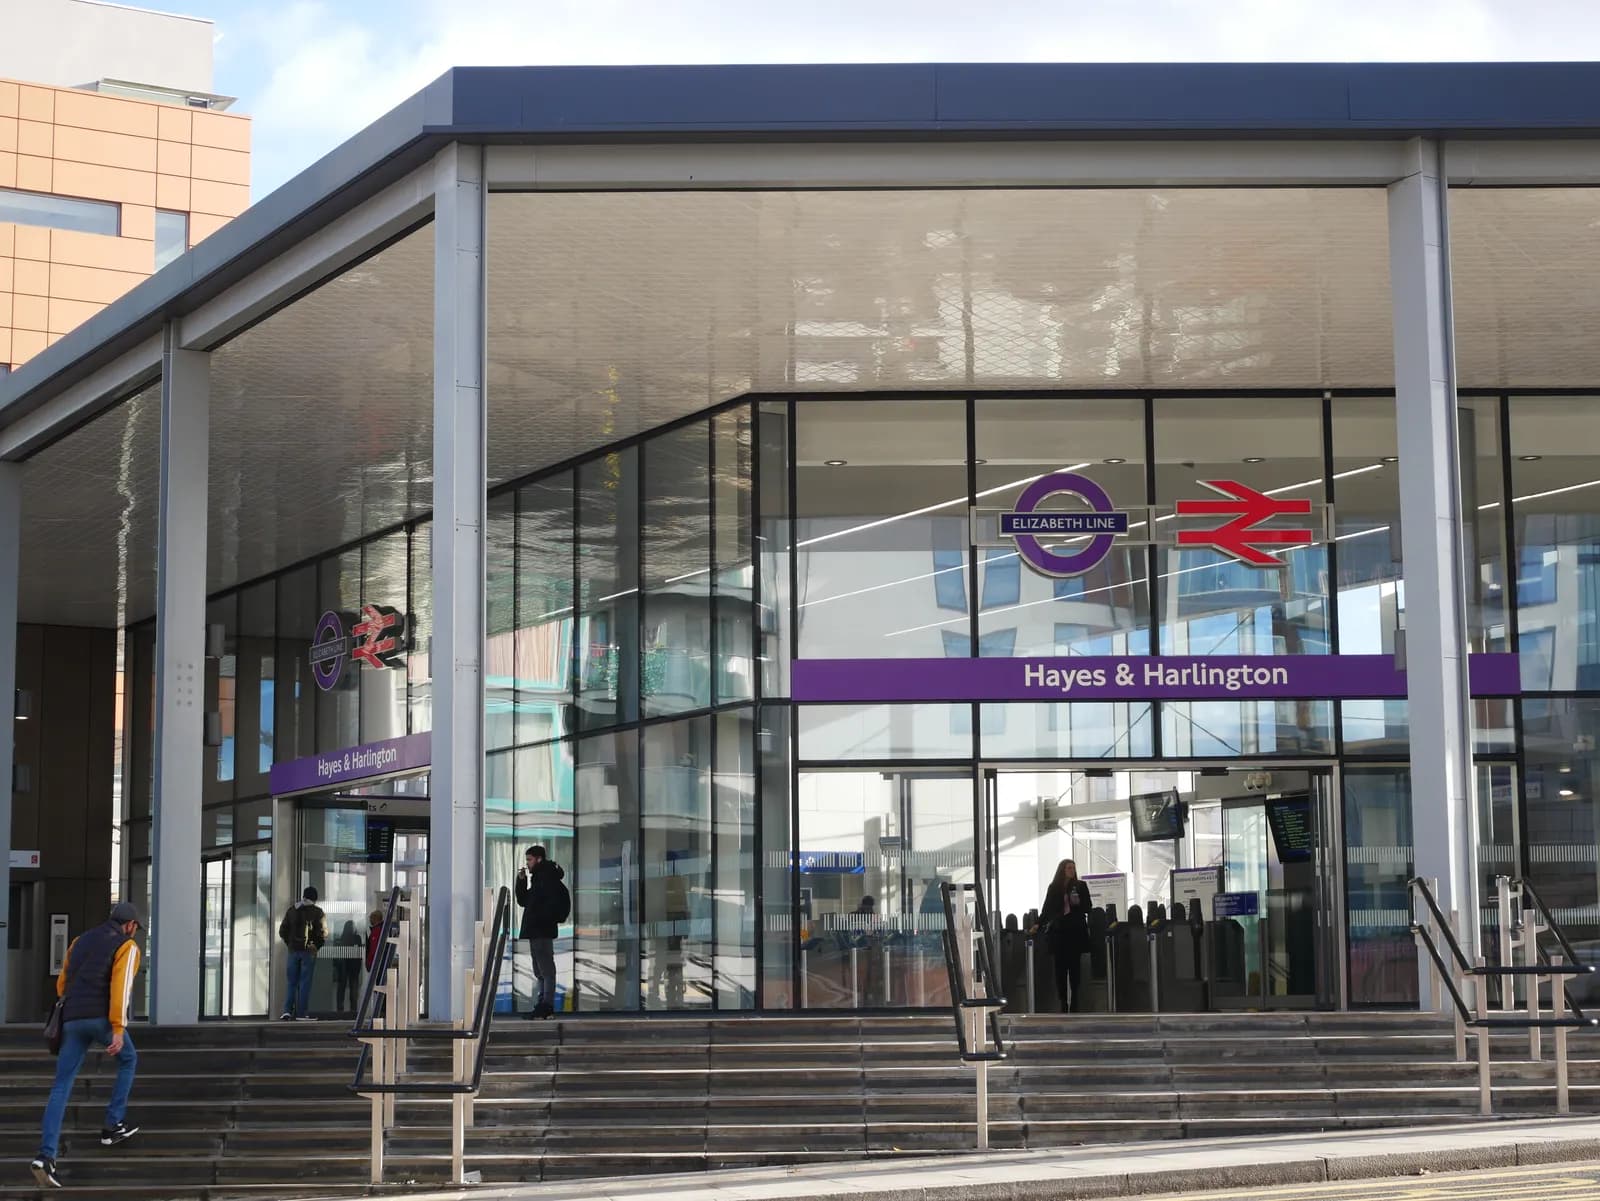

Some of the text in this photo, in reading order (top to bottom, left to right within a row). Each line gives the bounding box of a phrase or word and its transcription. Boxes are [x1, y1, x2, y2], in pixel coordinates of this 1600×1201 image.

[1012, 518, 1116, 529] ELIZABETH LINE
[1024, 663, 1288, 691] Hayes & Harlington
[318, 748, 397, 779] Hayes & Harlington
